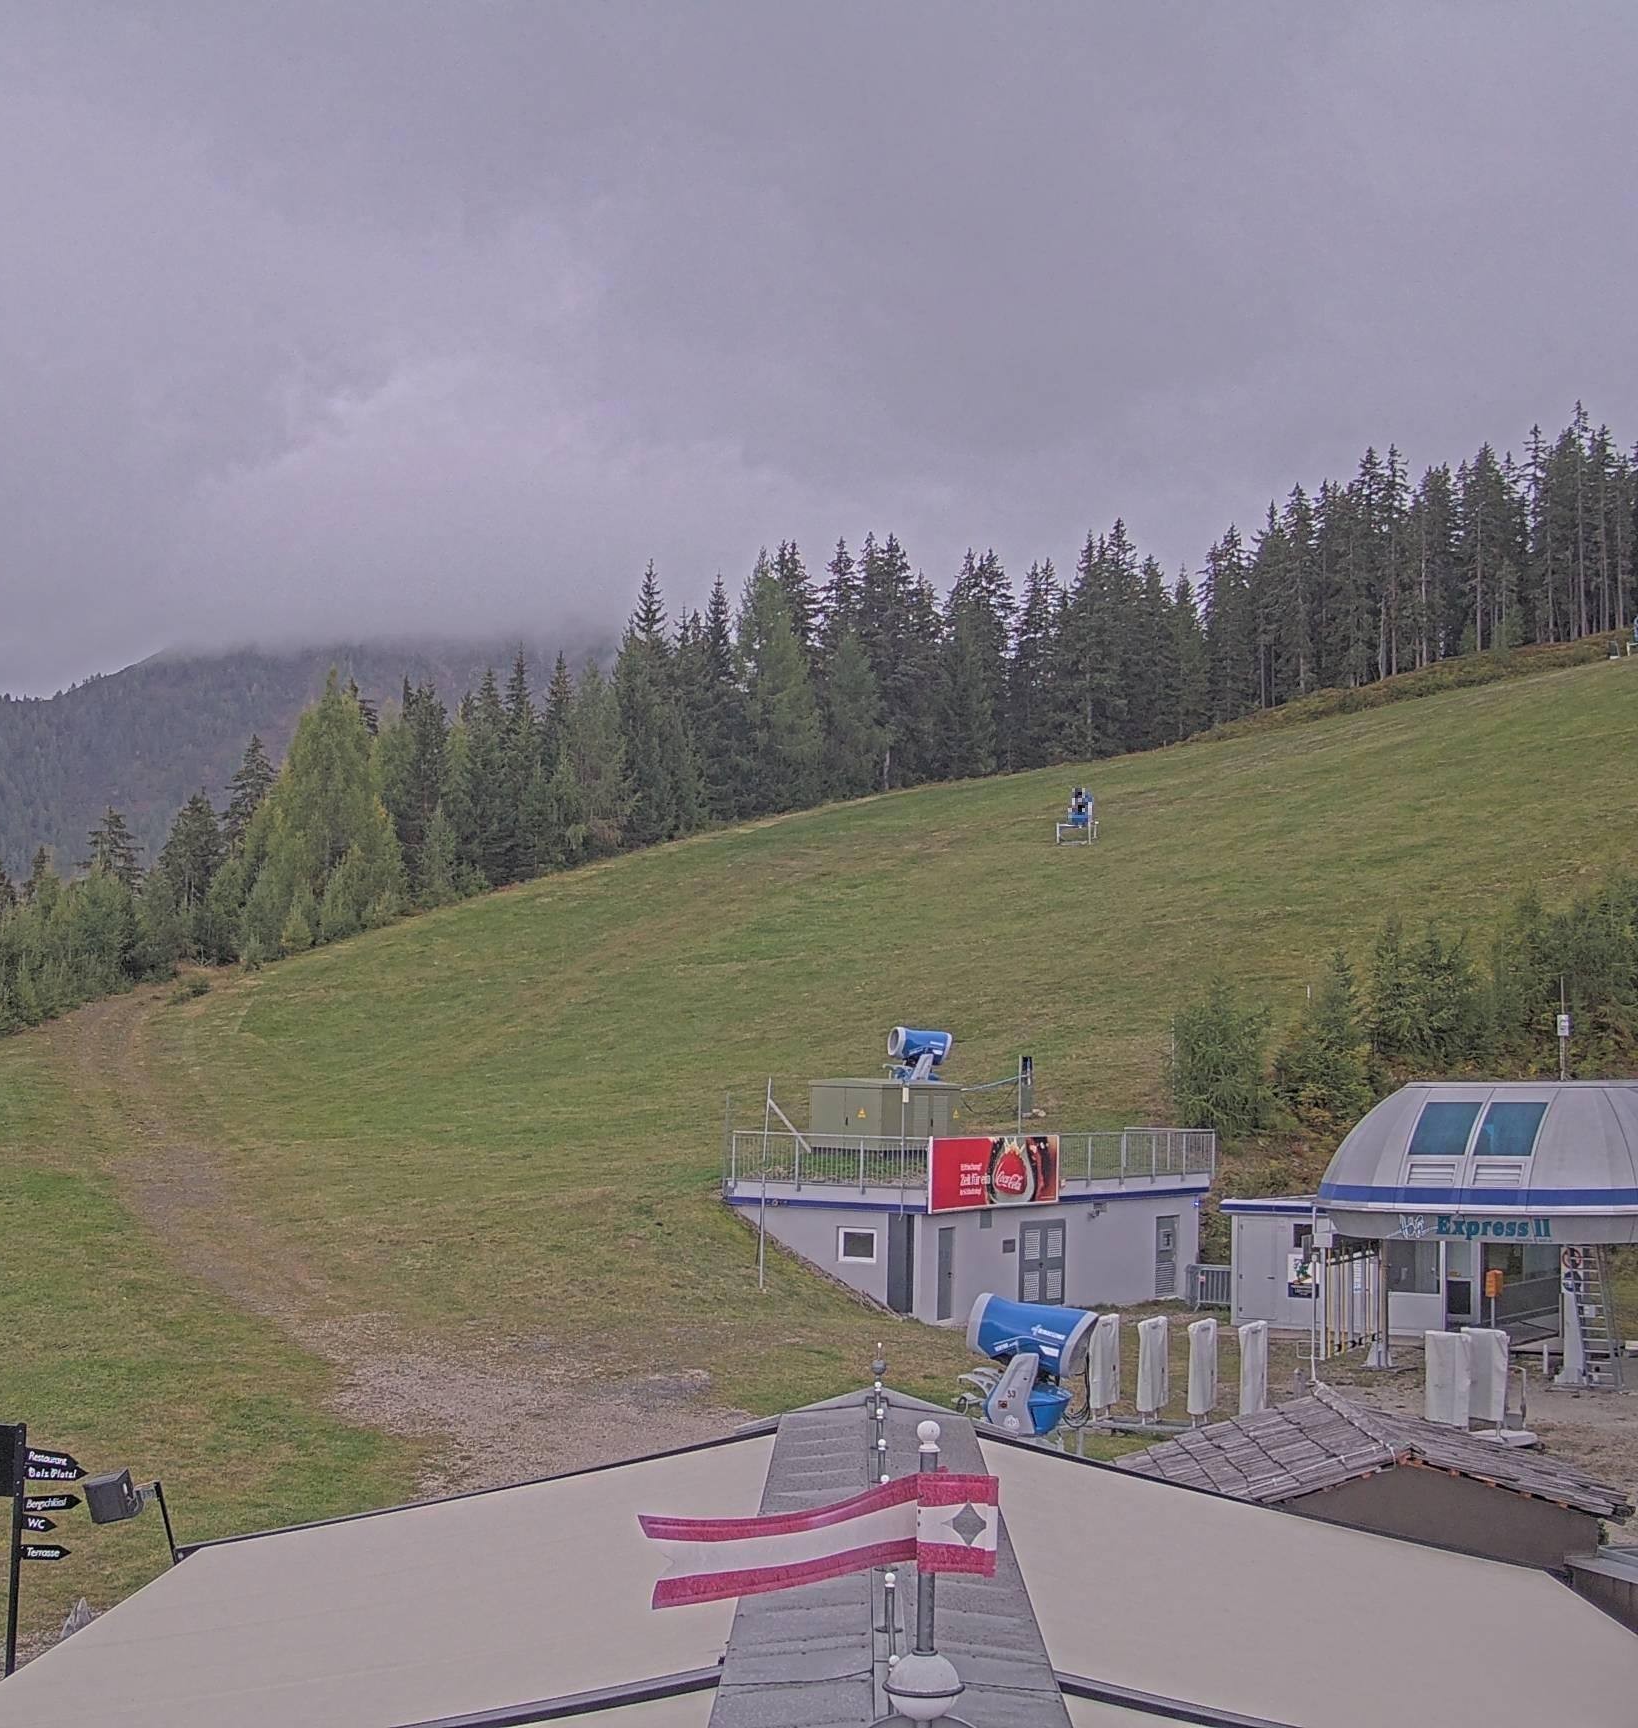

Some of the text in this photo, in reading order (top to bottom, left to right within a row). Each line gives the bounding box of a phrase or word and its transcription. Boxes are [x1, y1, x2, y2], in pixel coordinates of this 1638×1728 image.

[1436, 1215, 1529, 1240] Express
[29, 1451, 67, 1466] Restaurant
[28, 1518, 46, 1529] WC
[27, 1546, 60, 1557] Terrasse
